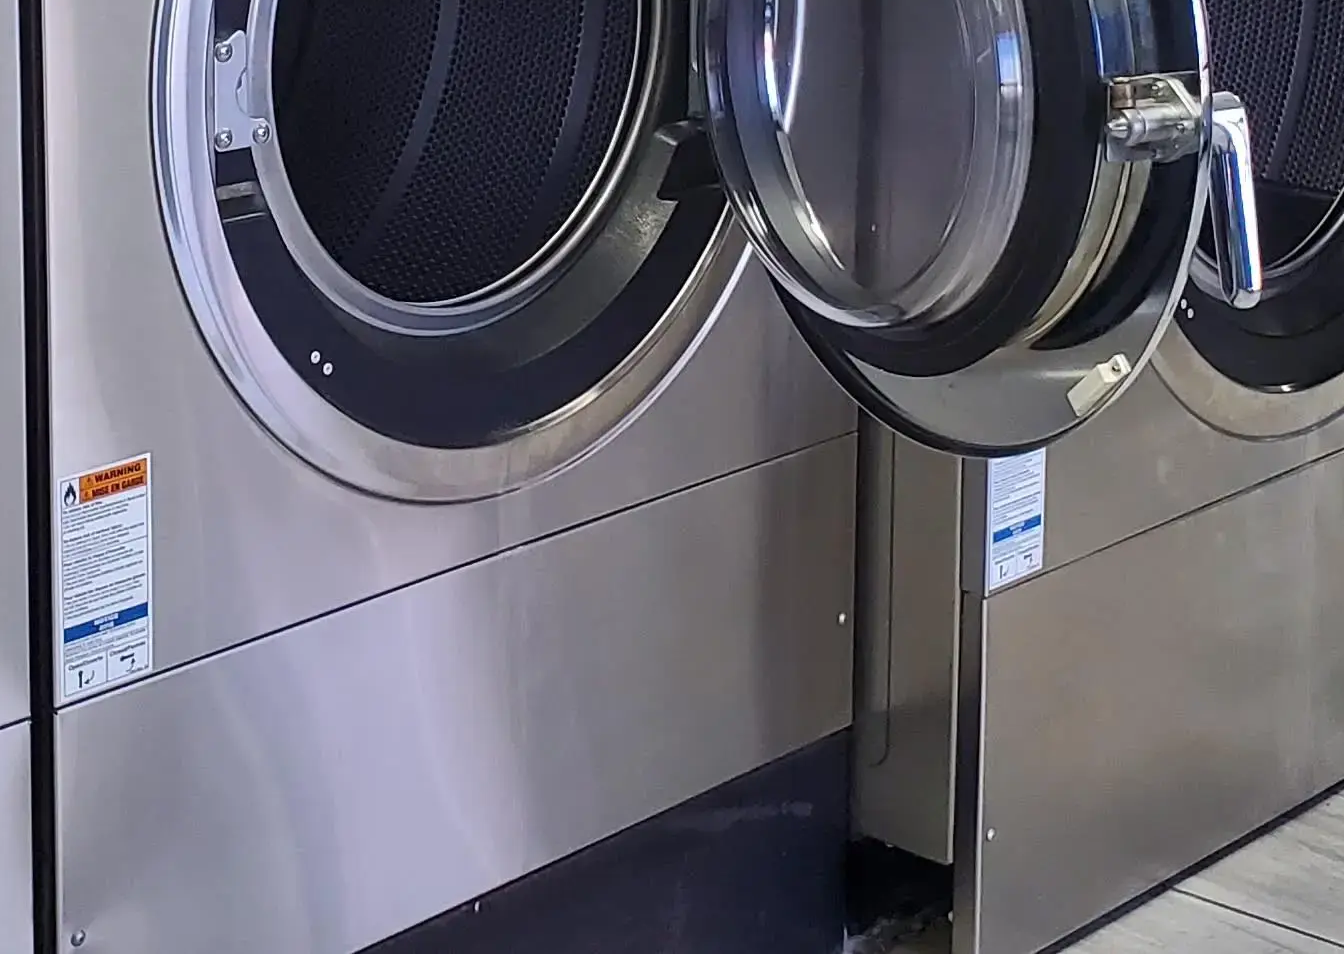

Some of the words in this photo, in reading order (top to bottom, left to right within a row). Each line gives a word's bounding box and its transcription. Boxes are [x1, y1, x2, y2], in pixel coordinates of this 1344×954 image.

[95, 462, 142, 483] WARNING
[92, 485, 109, 498] MISE
[111, 483, 120, 493] EN
[122, 475, 144, 489] GARDE
